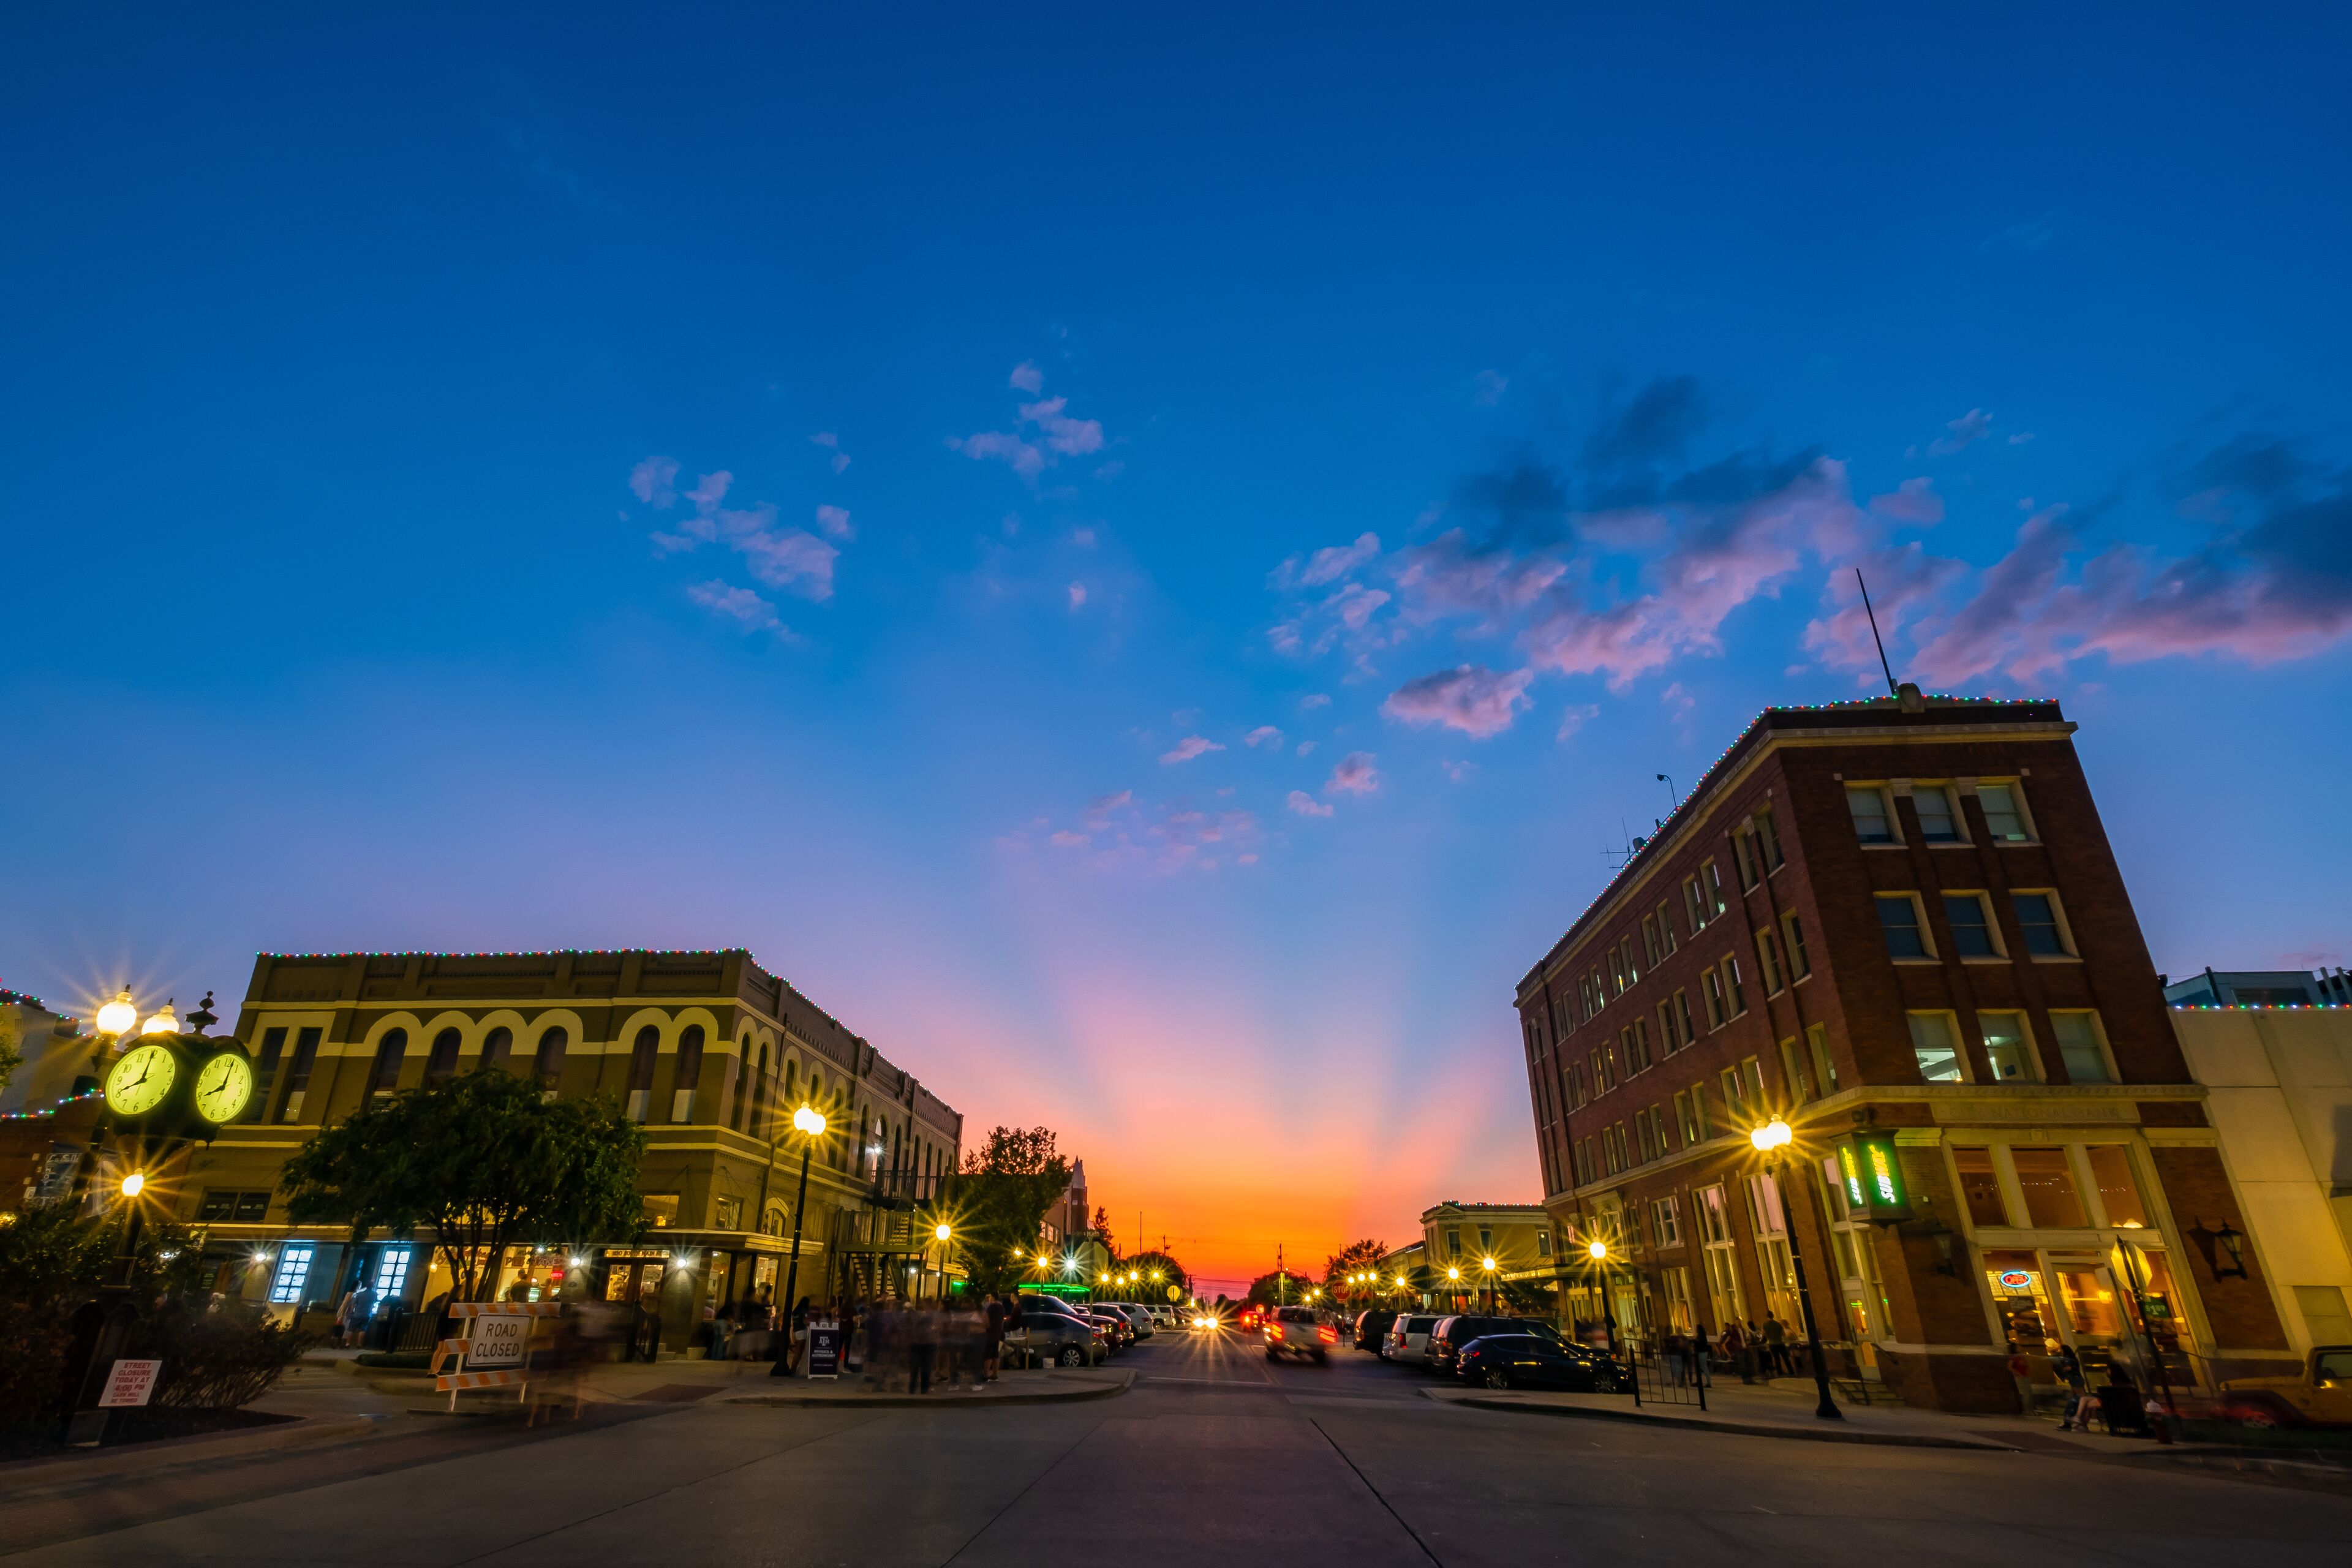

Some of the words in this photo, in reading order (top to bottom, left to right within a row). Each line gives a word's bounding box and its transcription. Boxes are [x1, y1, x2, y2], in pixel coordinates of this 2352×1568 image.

[136, 1054, 143, 1063] 11
[162, 1054, 167, 1063] 1
[167, 1063, 173, 1073] 2
[214, 1059, 221, 1068] 11
[122, 1064, 132, 1073] 10
[203, 1068, 211, 1077] 10
[234, 1064, 239, 1074] 1
[116, 1076, 123, 1085] 9
[166, 1076, 172, 1085] 3
[197, 1079, 202, 1088] 9
[238, 1076, 244, 1085] 2
[115, 1089, 122, 1098] 8
[159, 1088, 165, 1098] 4
[237, 1087, 243, 1096] 3
[196, 1092, 202, 1101] 8
[122, 1099, 127, 1109] 7
[133, 1102, 139, 1112] 6
[147, 1098, 154, 1108] 5
[231, 1099, 237, 1109] 4
[202, 1104, 206, 1113] 7
[221, 1107, 227, 1117] 5
[209, 1109, 216, 1118] 6
[1842, 1147, 1863, 1205] SUBWAY
[1869, 1145, 1896, 1204] SUBWAY
[2004, 1275, 2028, 1284] OPEN
[486, 1323, 518, 1337] ROAD
[476, 1343, 519, 1357] CLOSED
